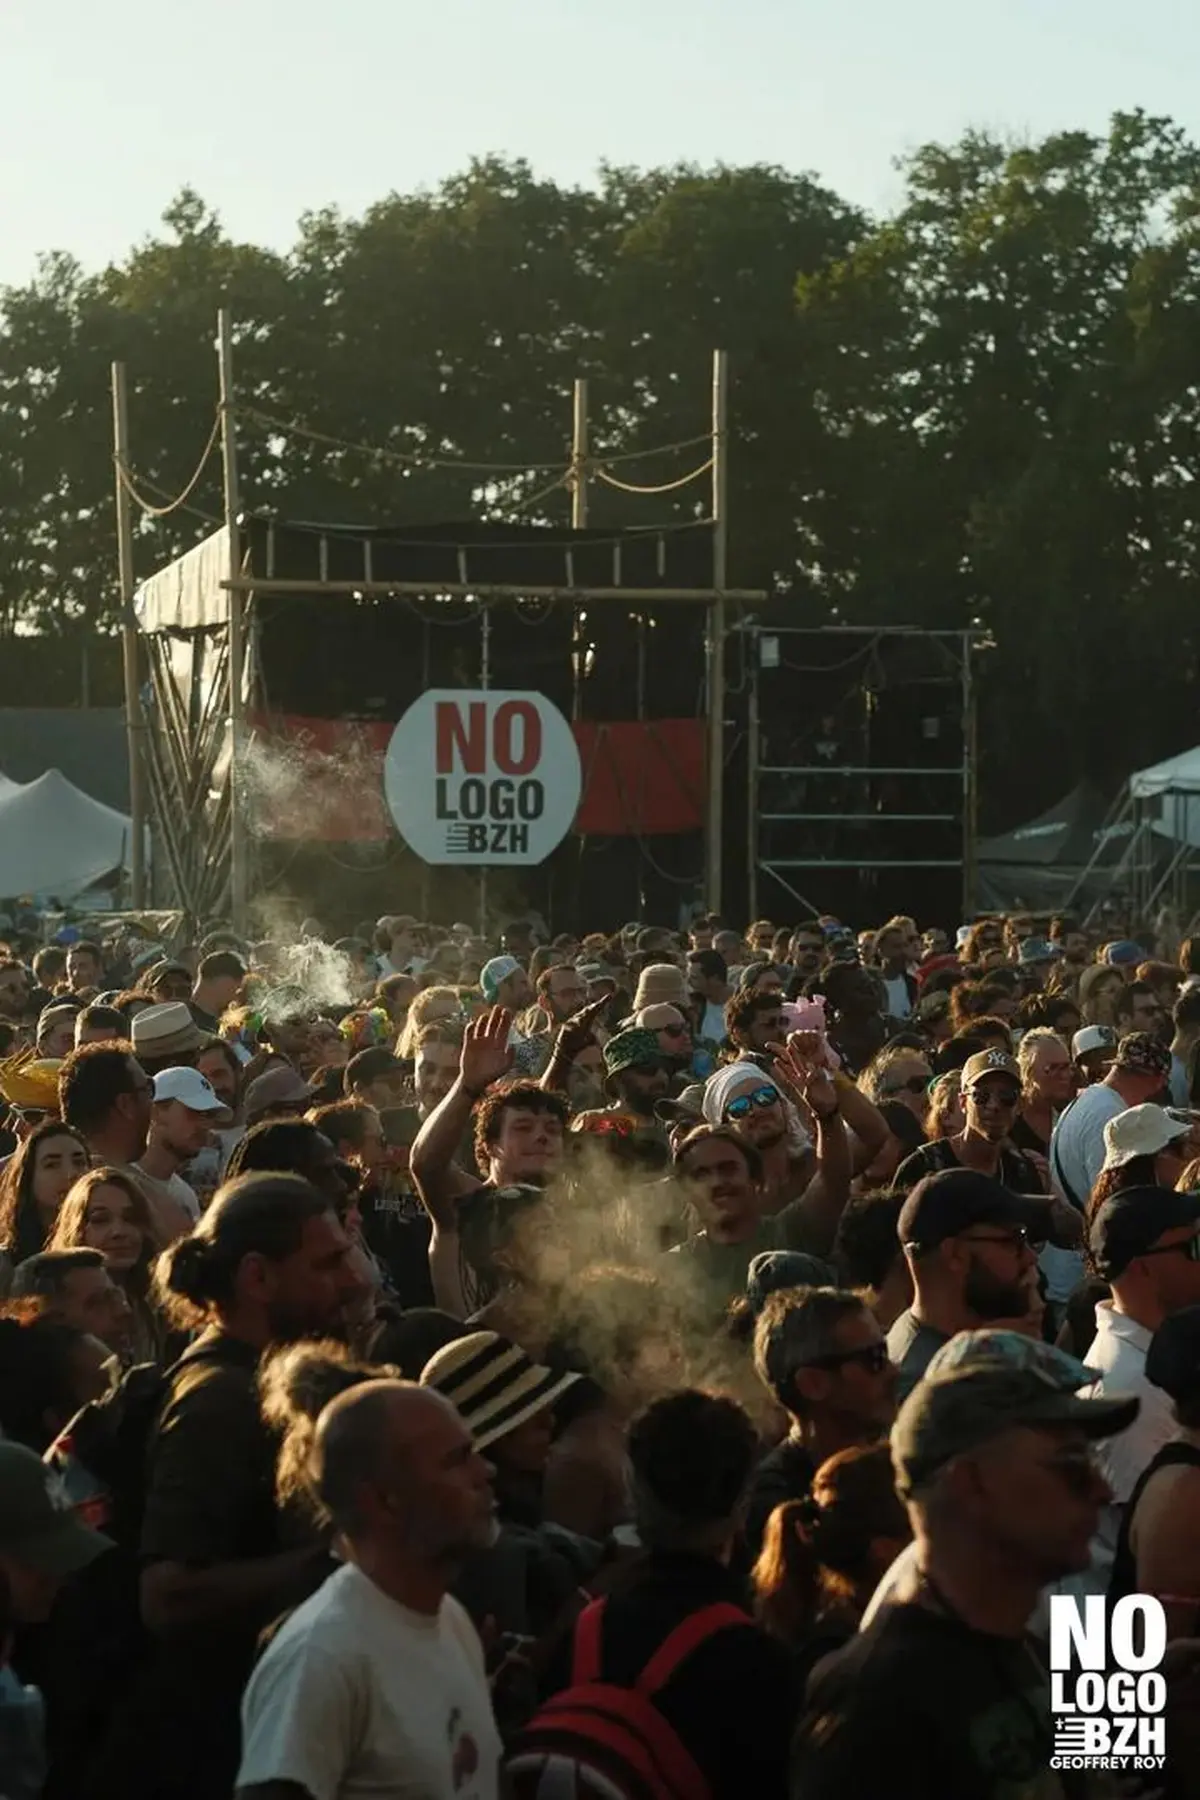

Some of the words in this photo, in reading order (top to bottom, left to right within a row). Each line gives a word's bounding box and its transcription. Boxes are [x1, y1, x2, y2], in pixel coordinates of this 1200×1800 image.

[435, 700, 542, 775] NO
[435, 778, 544, 821] LOGO
[467, 823, 529, 854] BZH
